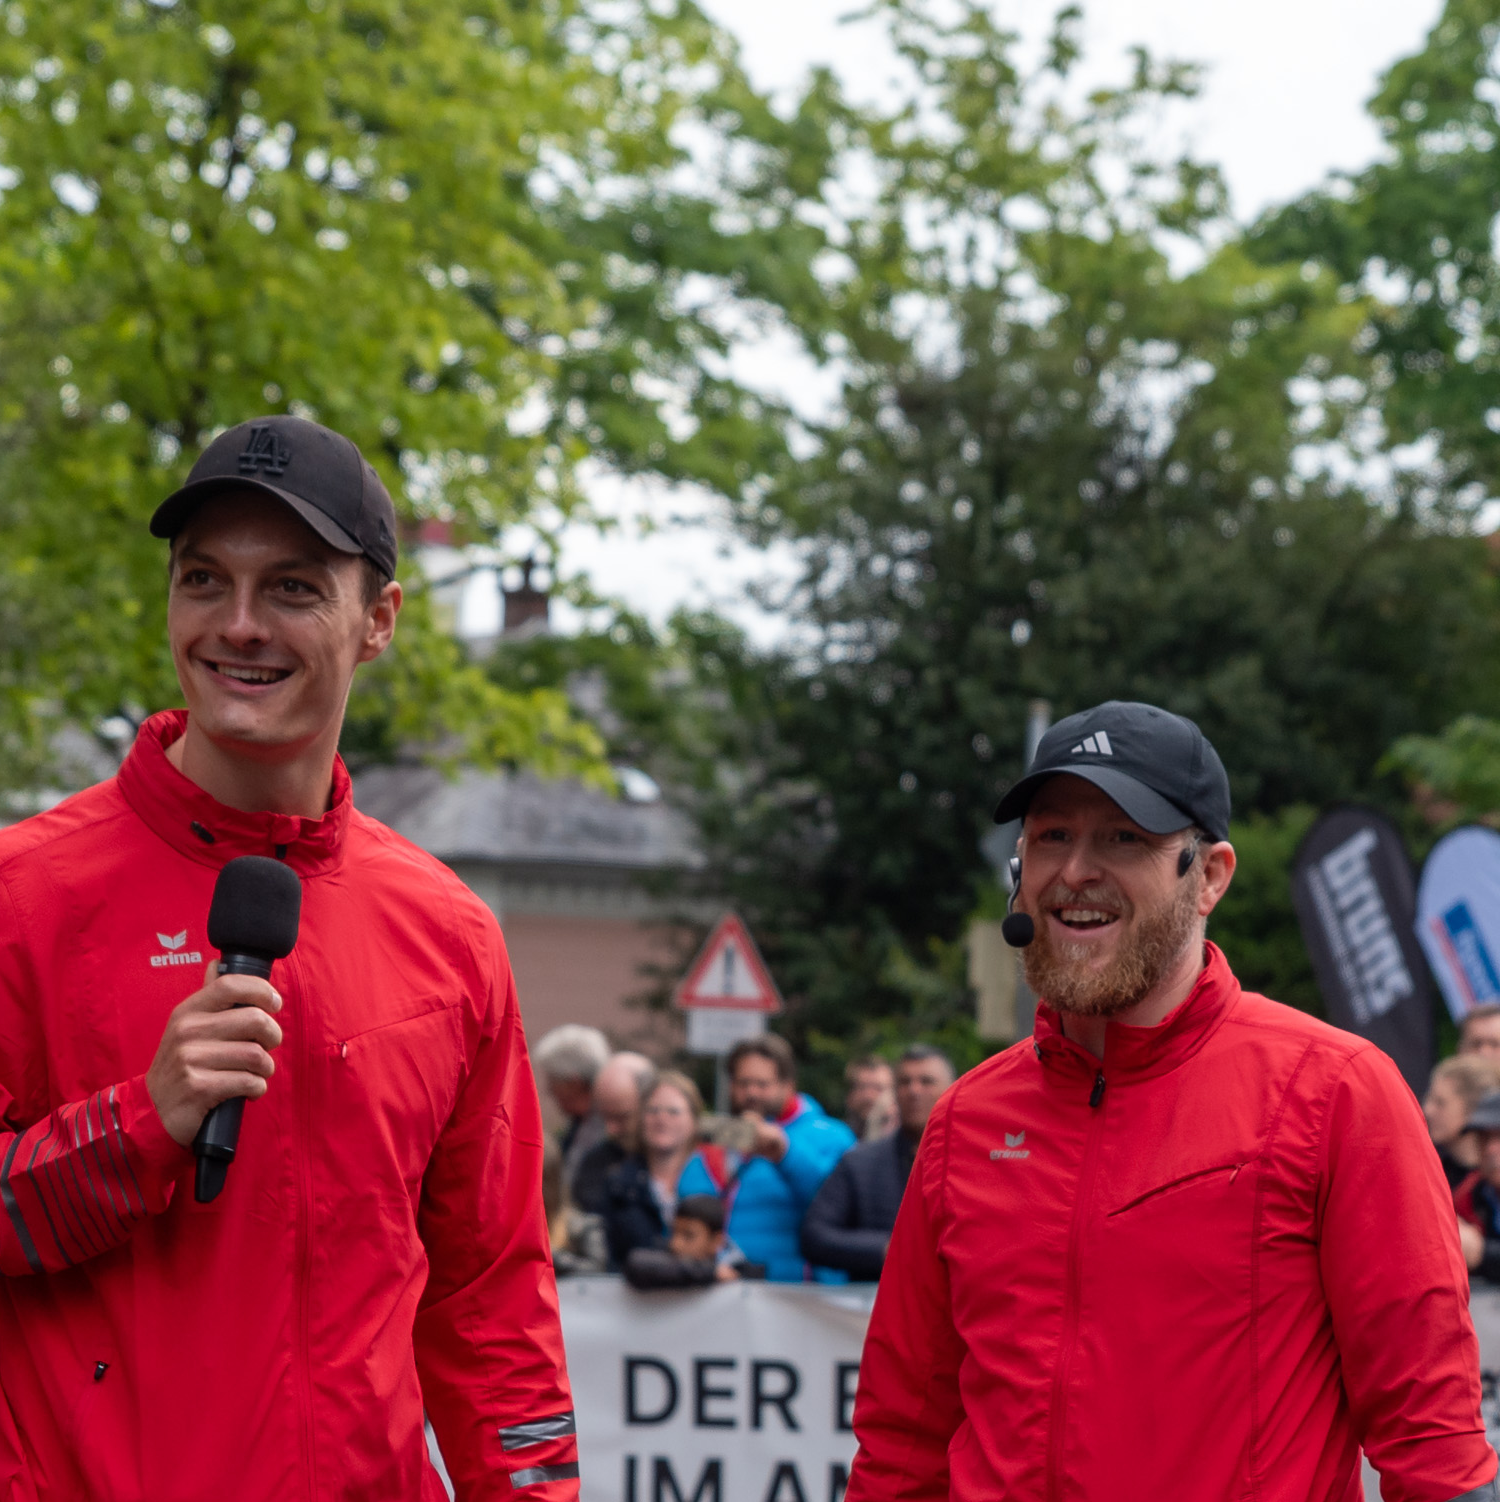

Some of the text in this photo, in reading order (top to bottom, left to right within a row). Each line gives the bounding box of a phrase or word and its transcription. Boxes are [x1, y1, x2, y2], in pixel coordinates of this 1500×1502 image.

[150, 951, 202, 967] erima
[1322, 827, 1414, 1016] bruns
[625, 1356, 799, 1432] DER
